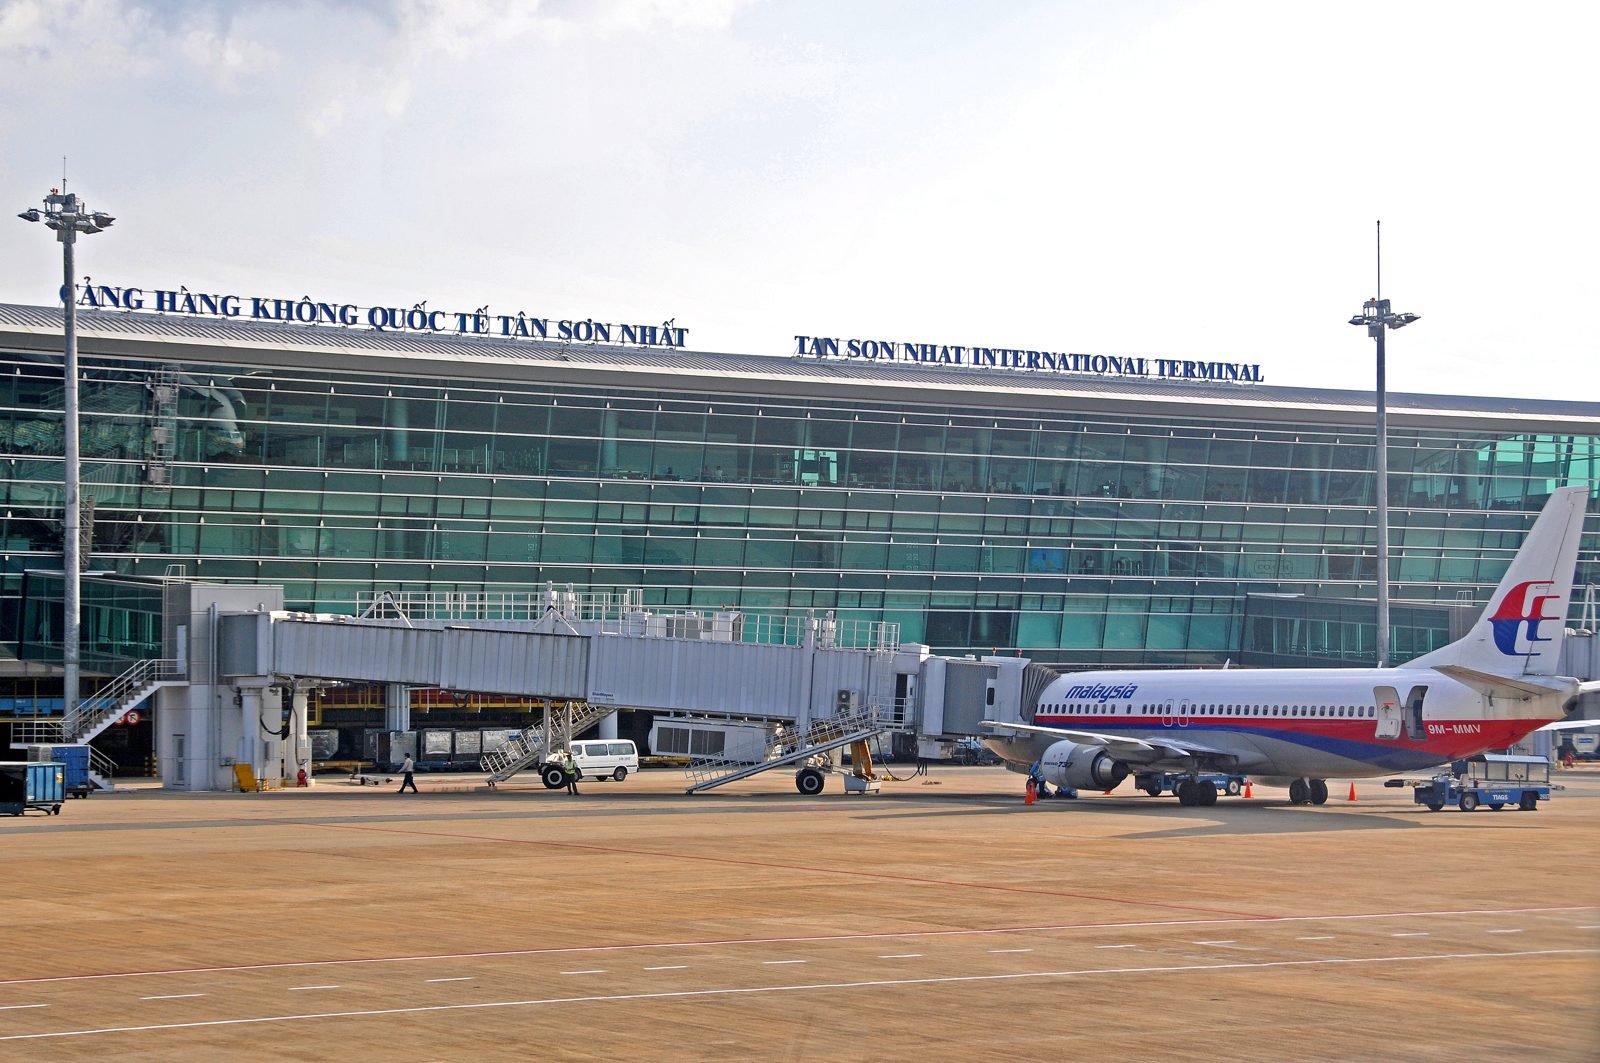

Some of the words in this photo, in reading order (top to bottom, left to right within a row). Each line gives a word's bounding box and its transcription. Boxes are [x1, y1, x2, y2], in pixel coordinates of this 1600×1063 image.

[155, 285, 241, 317] HÀNG
[251, 295, 359, 325] KHÔNG
[367, 300, 446, 332] QUỐC
[454, 305, 490, 334] TẾ
[497, 311, 548, 338] TÂN
[557, 318, 610, 342] SƠN
[621, 318, 690, 347] NHẤT
[794, 335, 839, 357] TAN
[847, 338, 895, 359] SON
[904, 342, 965, 364] NHAT
[973, 347, 1150, 376] INTERNATIONAL
[1155, 358, 1264, 382] TERMINAL
[1065, 682, 1138, 703] malaysia
[1427, 724, 1482, 735] 9M-MMV
